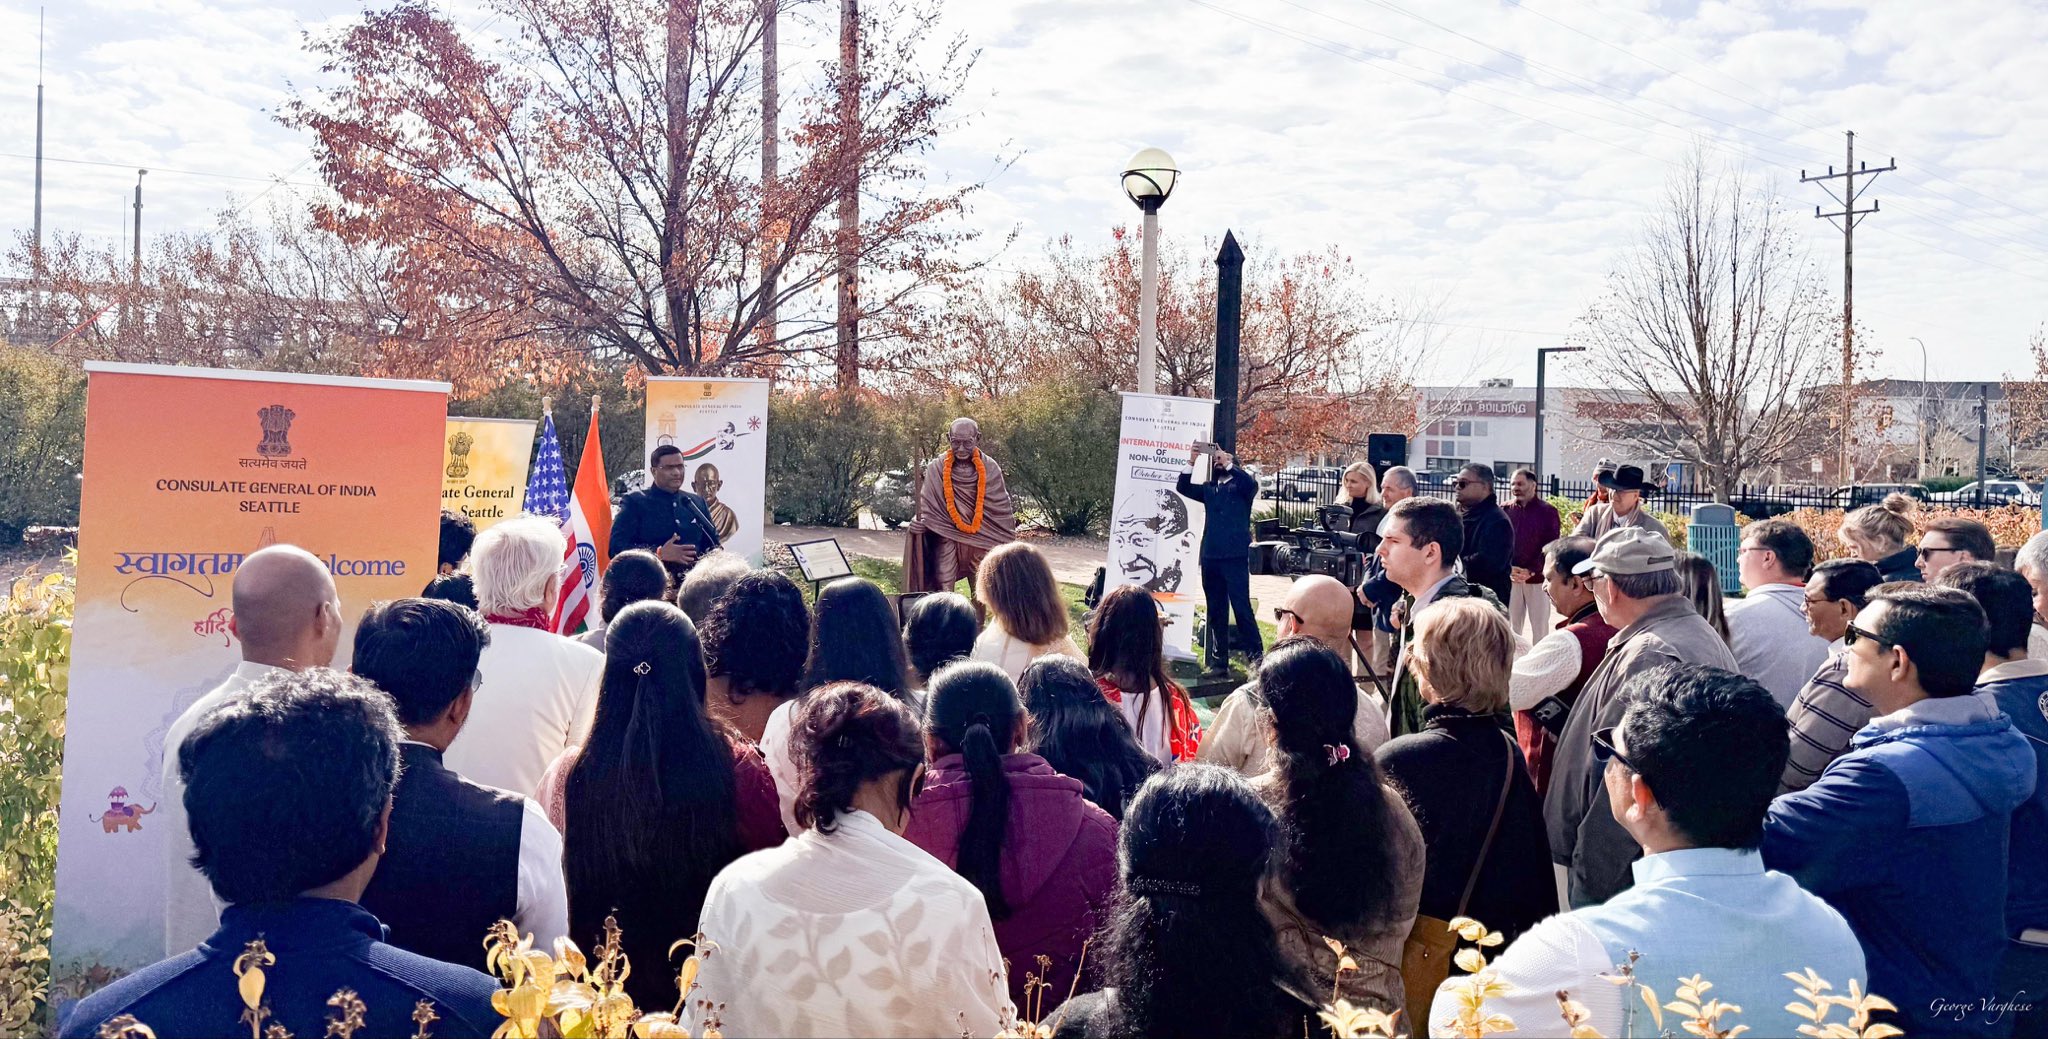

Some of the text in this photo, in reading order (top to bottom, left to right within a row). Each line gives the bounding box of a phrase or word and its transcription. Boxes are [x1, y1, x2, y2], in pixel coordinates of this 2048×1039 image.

[1479, 403, 1526, 413] BUILDING
[1120, 438, 1184, 450] INTERNATIONAL
[238, 456, 307, 470] सत्यमेव जयते
[1128, 454, 1187, 465] NON-VIOLENC
[156, 479, 376, 497] CONSULATE GENERAL OF INDIA
[464, 485, 514, 498] General
[239, 500, 300, 513] SEATTLE
[461, 505, 504, 518] Seattle
